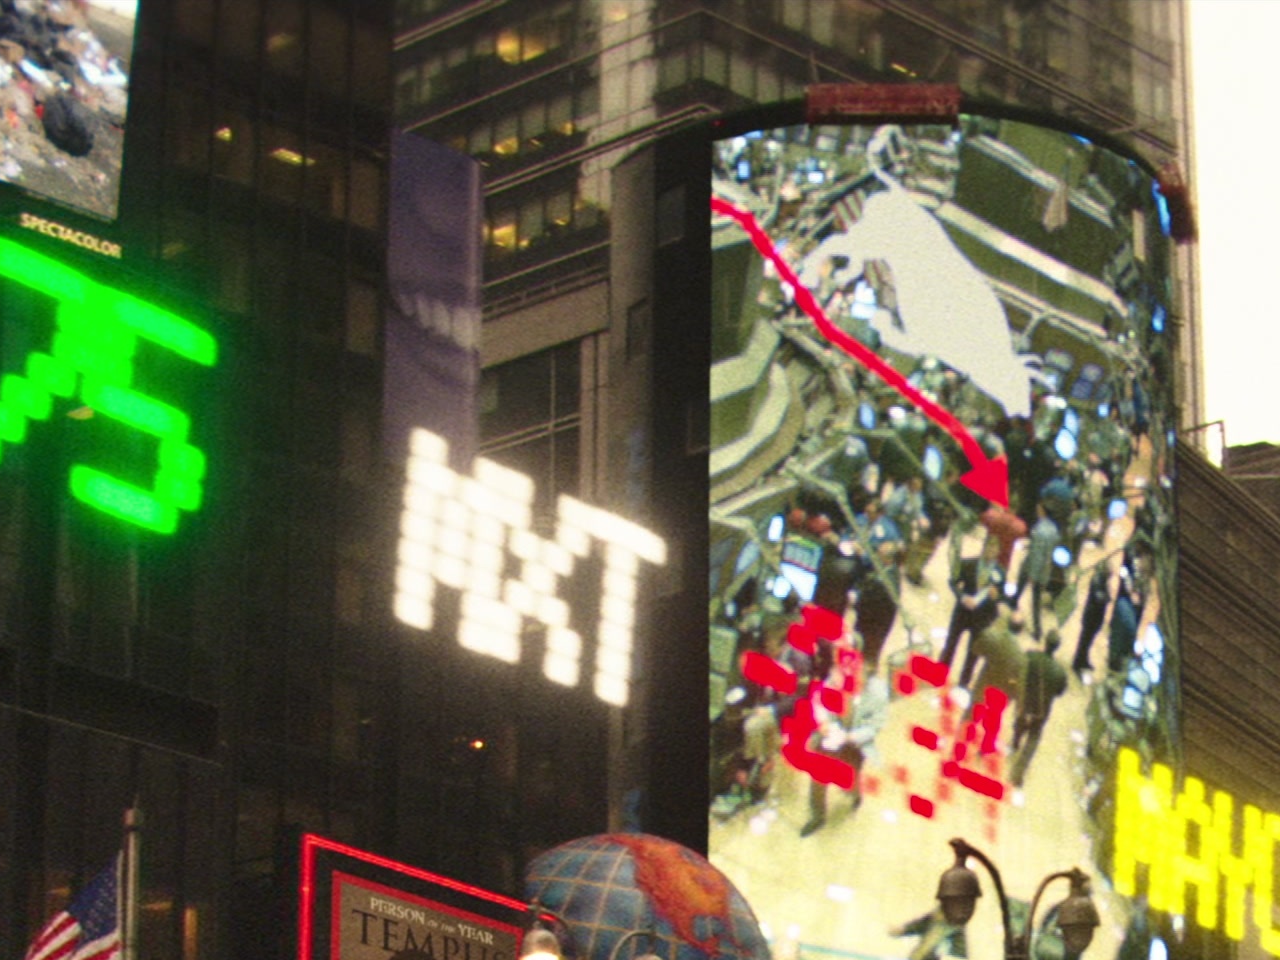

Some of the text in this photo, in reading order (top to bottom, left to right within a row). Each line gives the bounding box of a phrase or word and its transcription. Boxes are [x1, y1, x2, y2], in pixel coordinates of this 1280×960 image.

[19, 212, 122, 259] SPECTACOLOR
[392, 426, 668, 709] MXT
[371, 897, 426, 925] PERSON
[458, 924, 494, 946] YEAR
